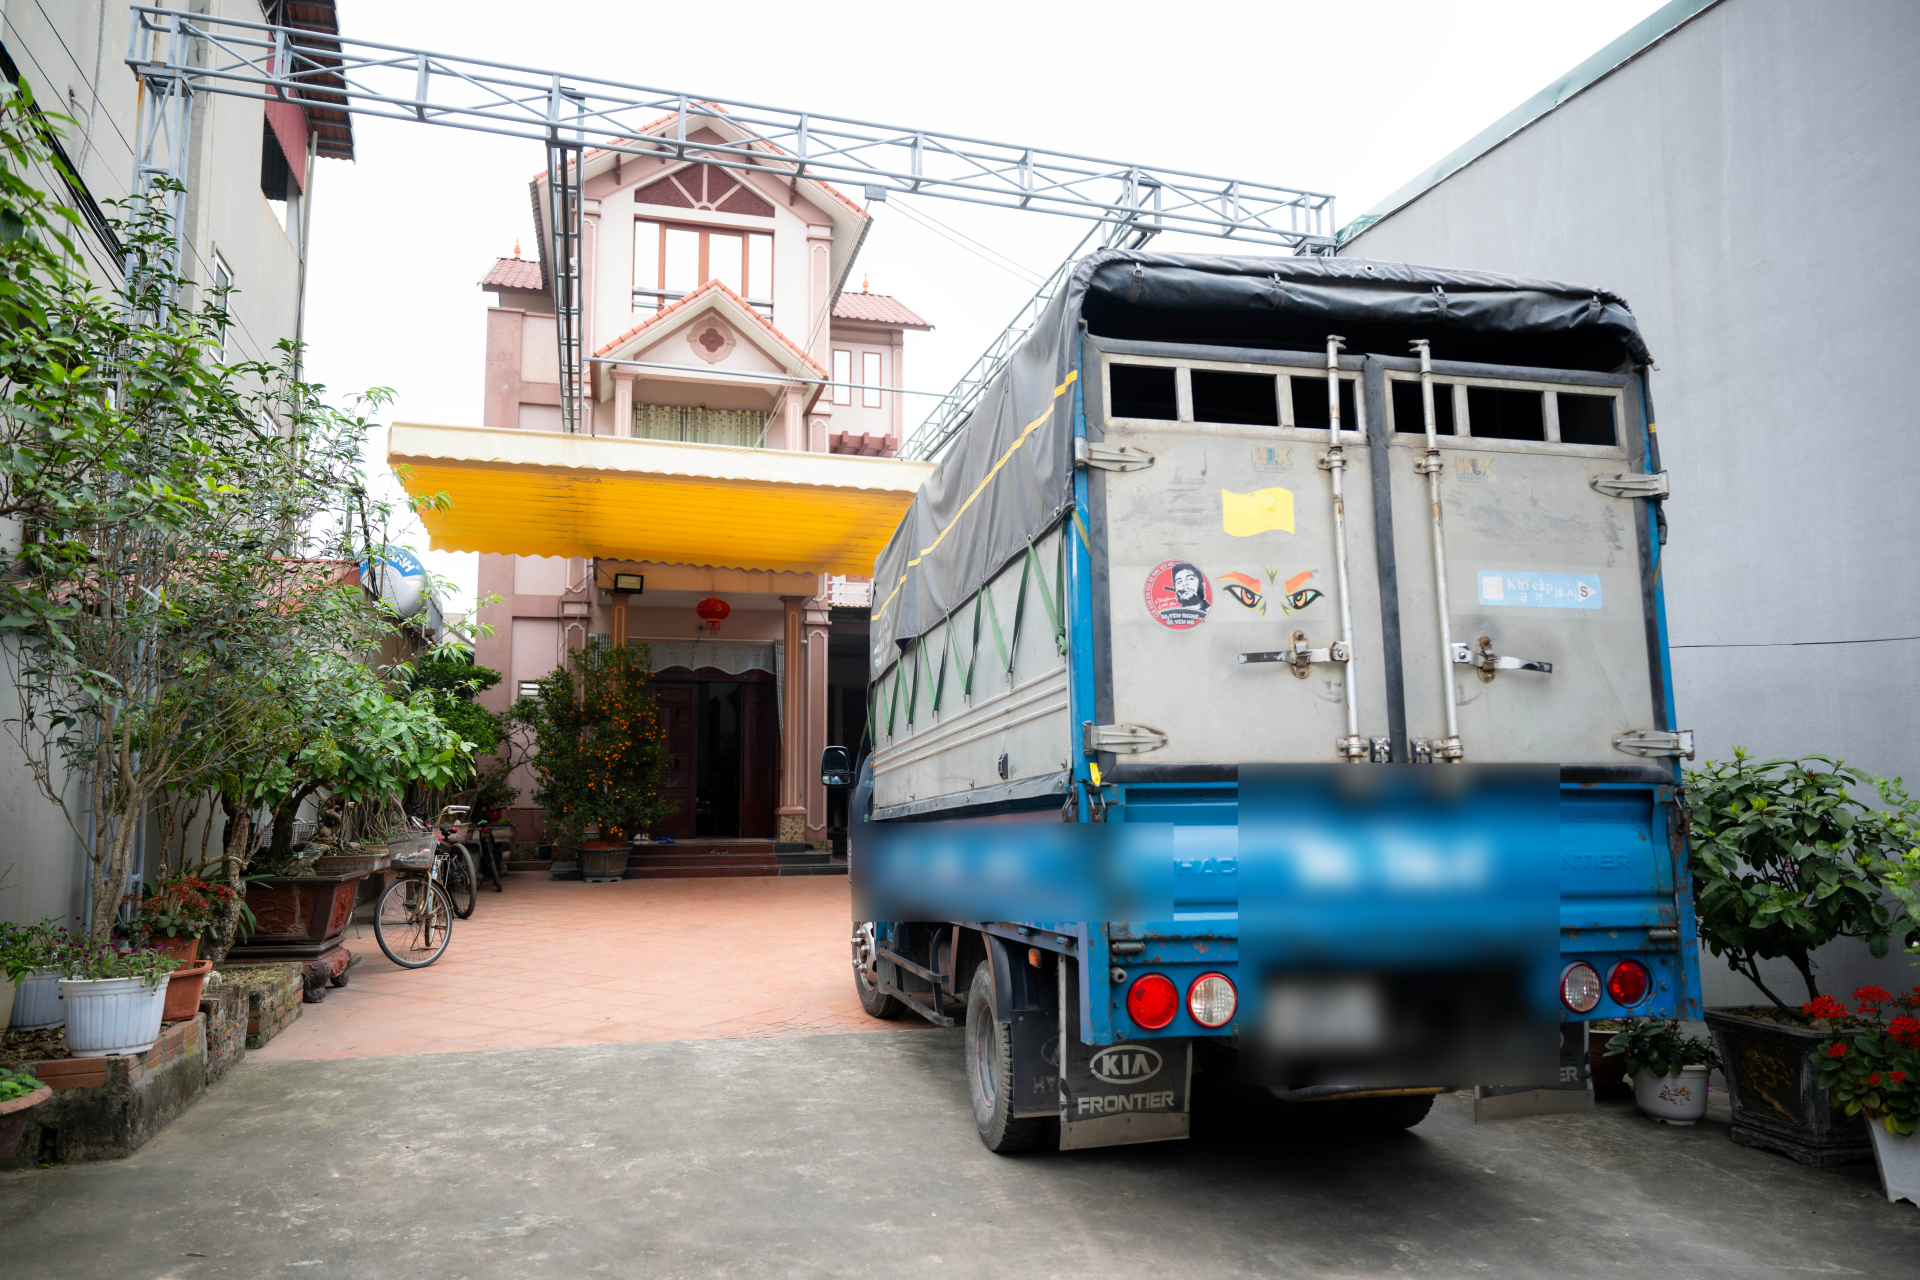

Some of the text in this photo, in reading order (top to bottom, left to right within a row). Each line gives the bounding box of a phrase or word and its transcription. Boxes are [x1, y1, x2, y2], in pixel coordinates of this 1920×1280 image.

[1506, 578, 1529, 590] Khí
[1532, 577, 1553, 594] cấp
[1580, 586, 1589, 597] S
[1174, 858, 1237, 876] HAC
[1560, 852, 1632, 870] NTIER
[1102, 1054, 1150, 1076] KIA
[1560, 1066, 1579, 1082] ER
[1033, 1076, 1059, 1094] HY
[1078, 1090, 1175, 1114] FRONTIER
